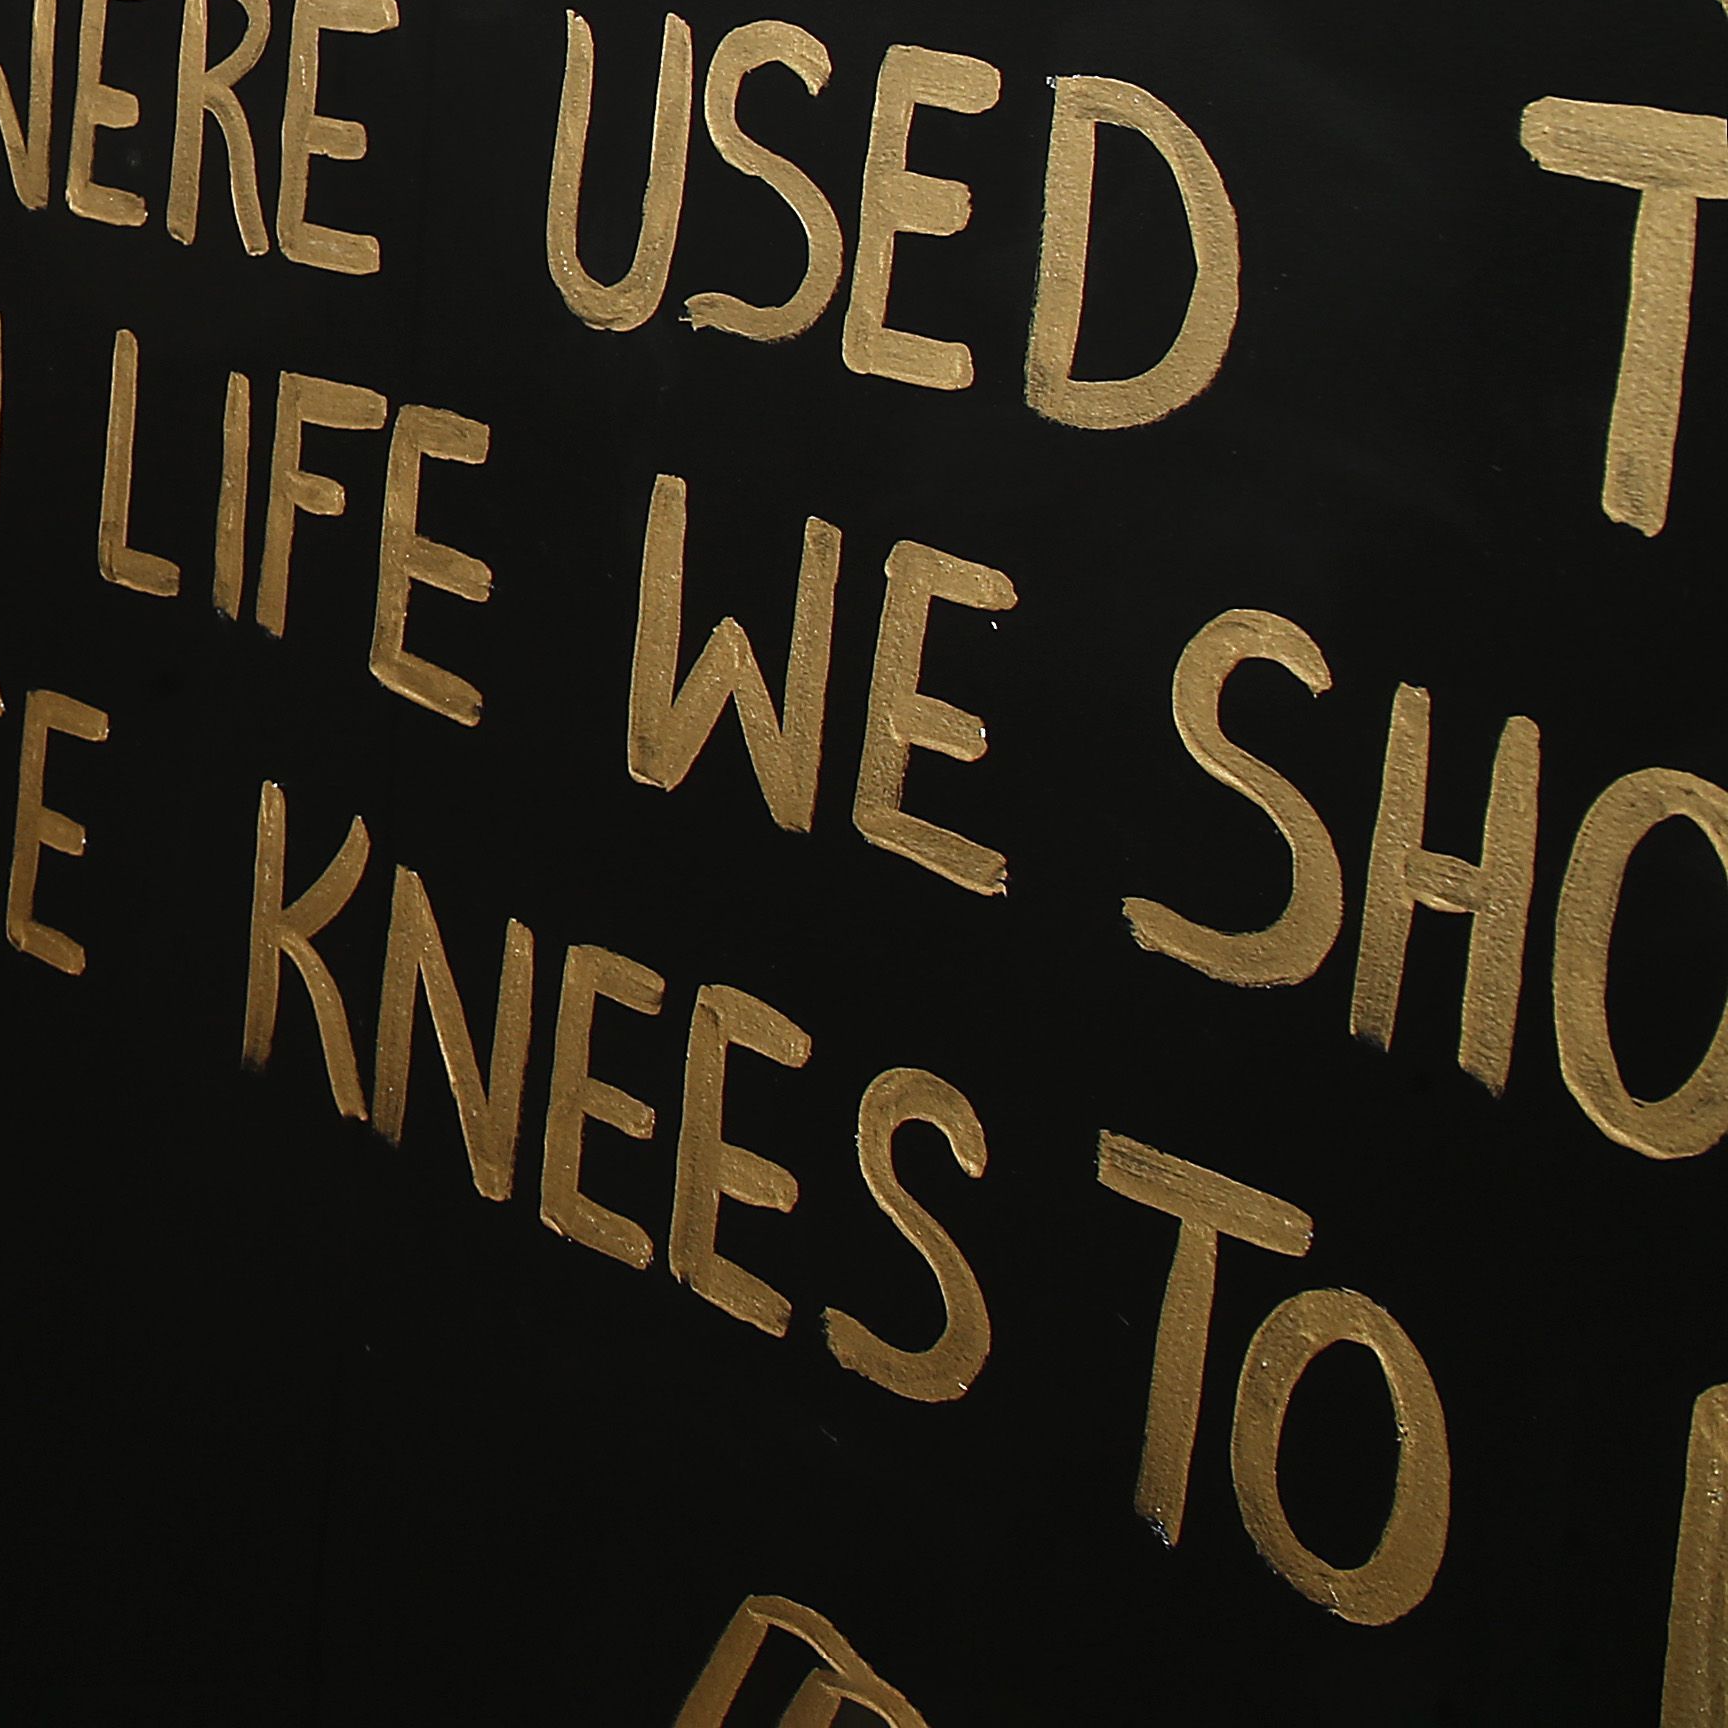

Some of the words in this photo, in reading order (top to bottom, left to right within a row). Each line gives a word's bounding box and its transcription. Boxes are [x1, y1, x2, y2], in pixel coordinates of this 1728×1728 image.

[547, 9, 1242, 430] USED
[97, 328, 494, 727] LIFE
[627, 474, 1019, 896] WE
[1122, 608, 1728, 1160] SHO
[242, 779, 994, 1404] KNEES
[1097, 1129, 1452, 1627] TO
